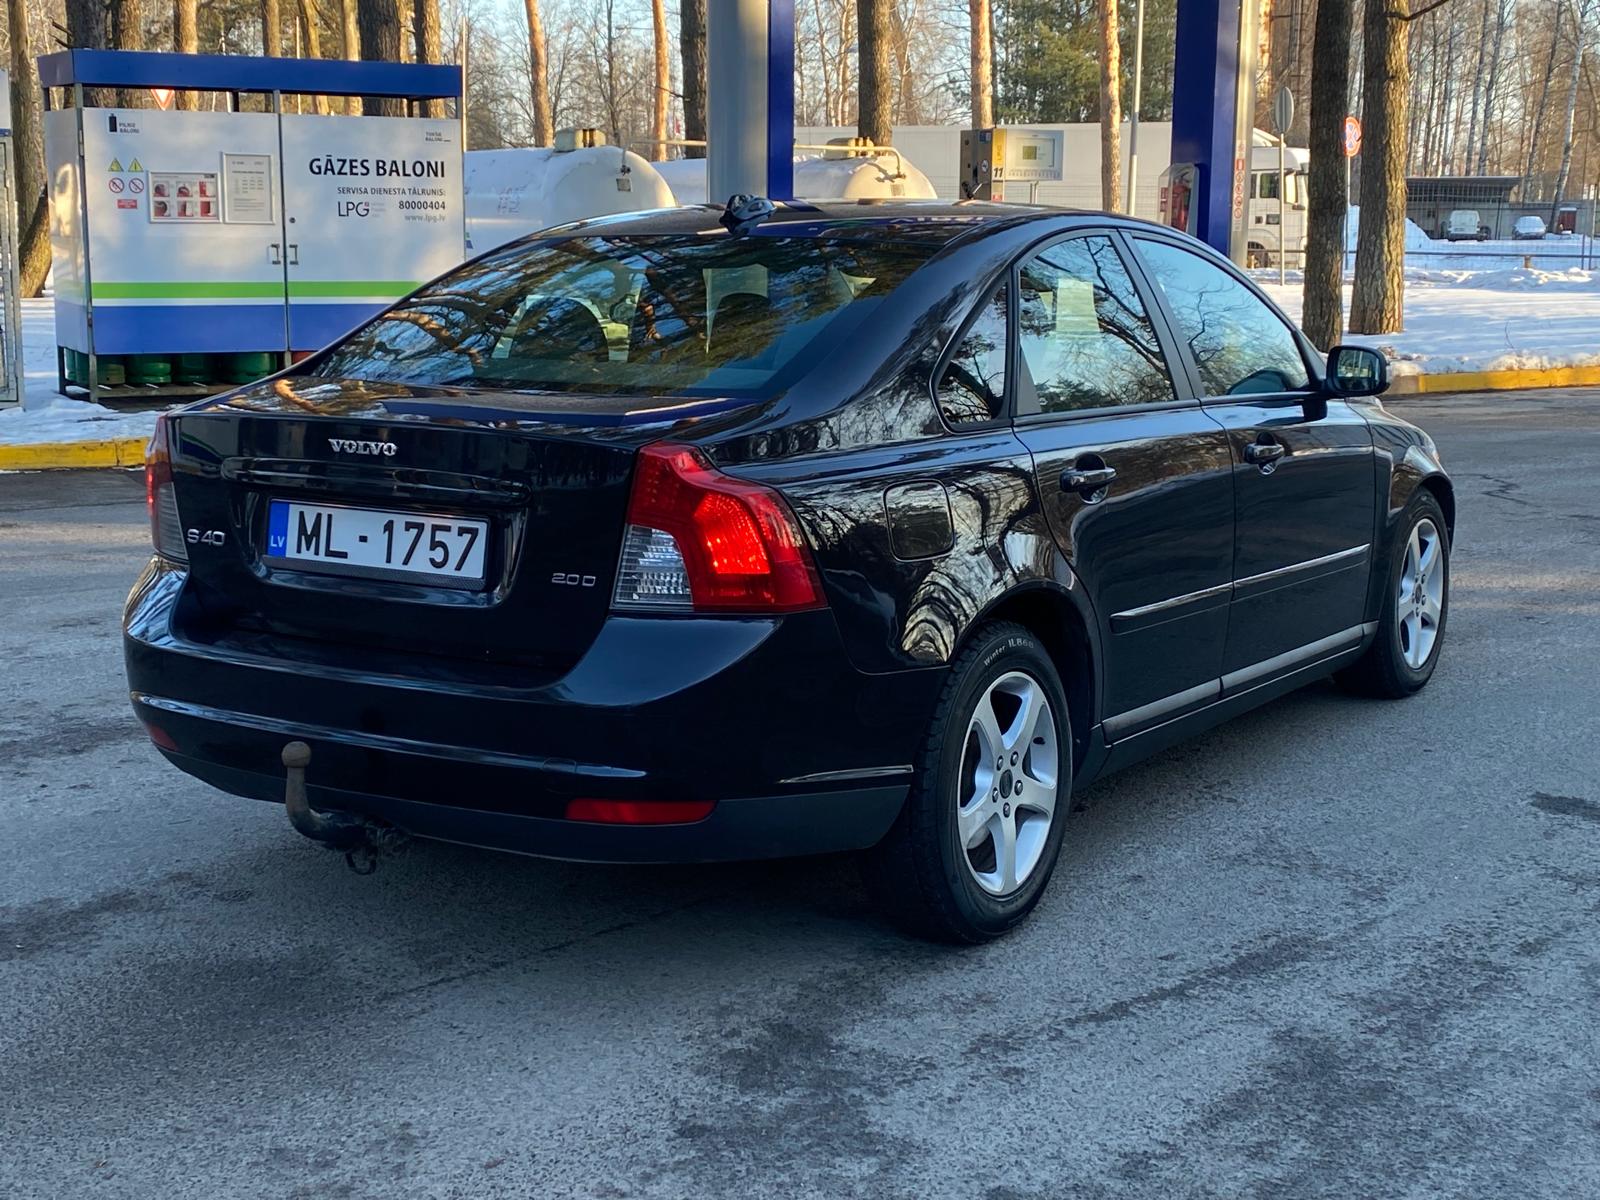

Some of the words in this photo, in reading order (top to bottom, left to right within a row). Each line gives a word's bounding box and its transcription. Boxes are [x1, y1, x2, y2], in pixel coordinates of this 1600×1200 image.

[309, 154, 370, 177] GĀZES
[375, 159, 446, 178] BALONI
[993, 167, 1004, 178] 11
[337, 186, 369, 195] SERVISA
[370, 188, 407, 196] DIENESTA
[407, 187, 447, 197] TĀLRUNIS:
[337, 201, 370, 218] LPG
[398, 200, 446, 210] 80000404
[404, 214, 446, 223] www.lpg.lv
[328, 438, 398, 456] VOLVO
[186, 528, 225, 546] S40
[270, 535, 285, 547] LV
[984, 645, 1006, 666] Winter
